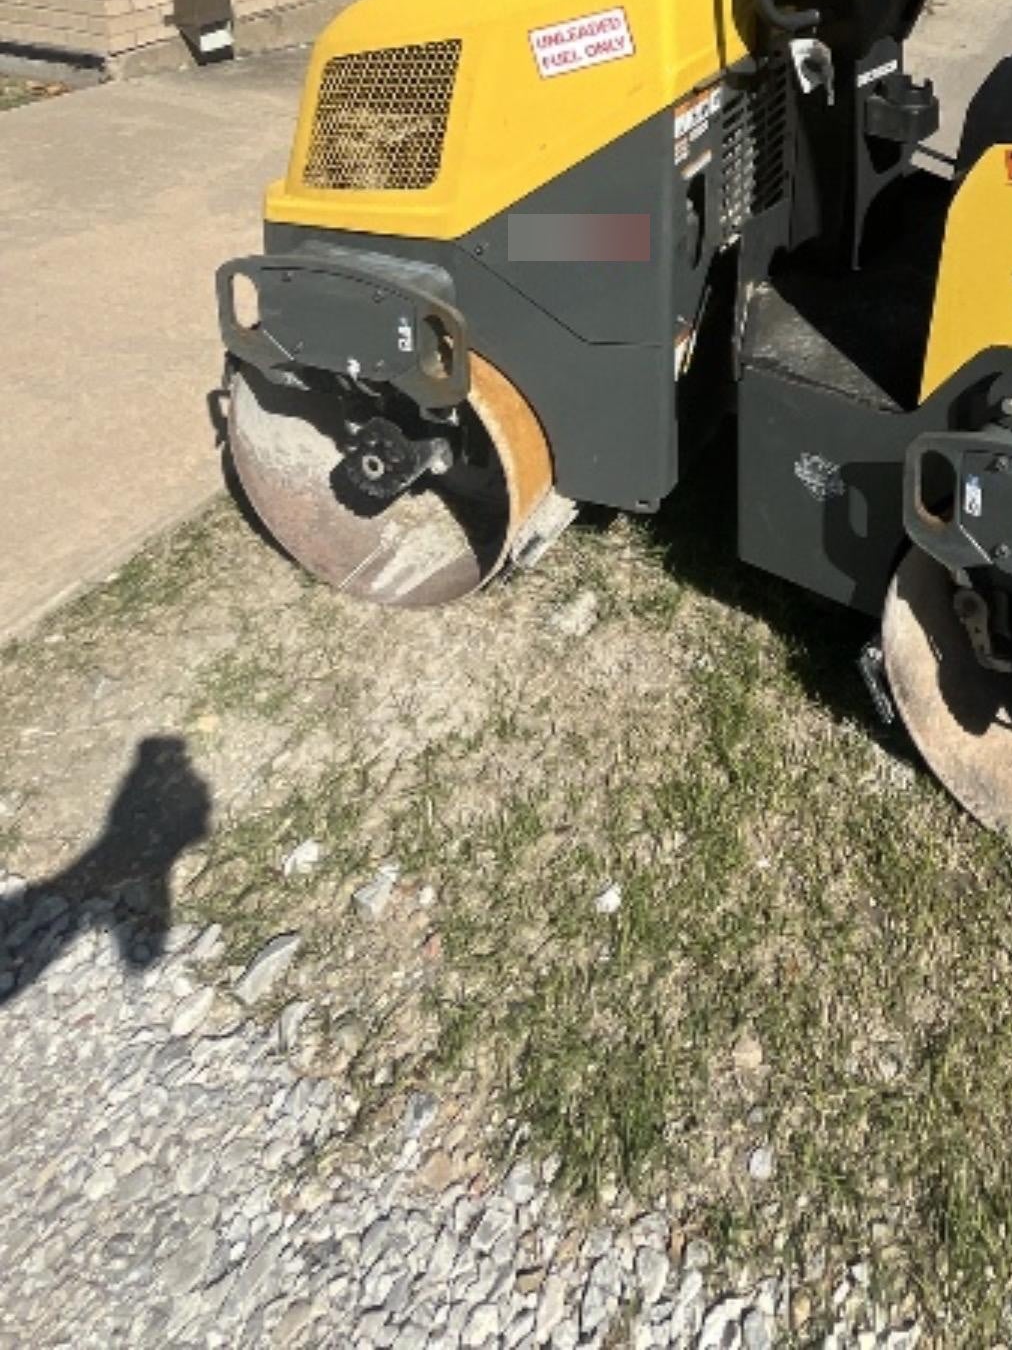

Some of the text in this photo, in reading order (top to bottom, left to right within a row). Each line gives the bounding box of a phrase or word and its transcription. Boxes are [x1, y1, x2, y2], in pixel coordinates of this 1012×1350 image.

[536, 16, 622, 49] UNLEADED
[542, 35, 626, 69] FUEL ONLY
